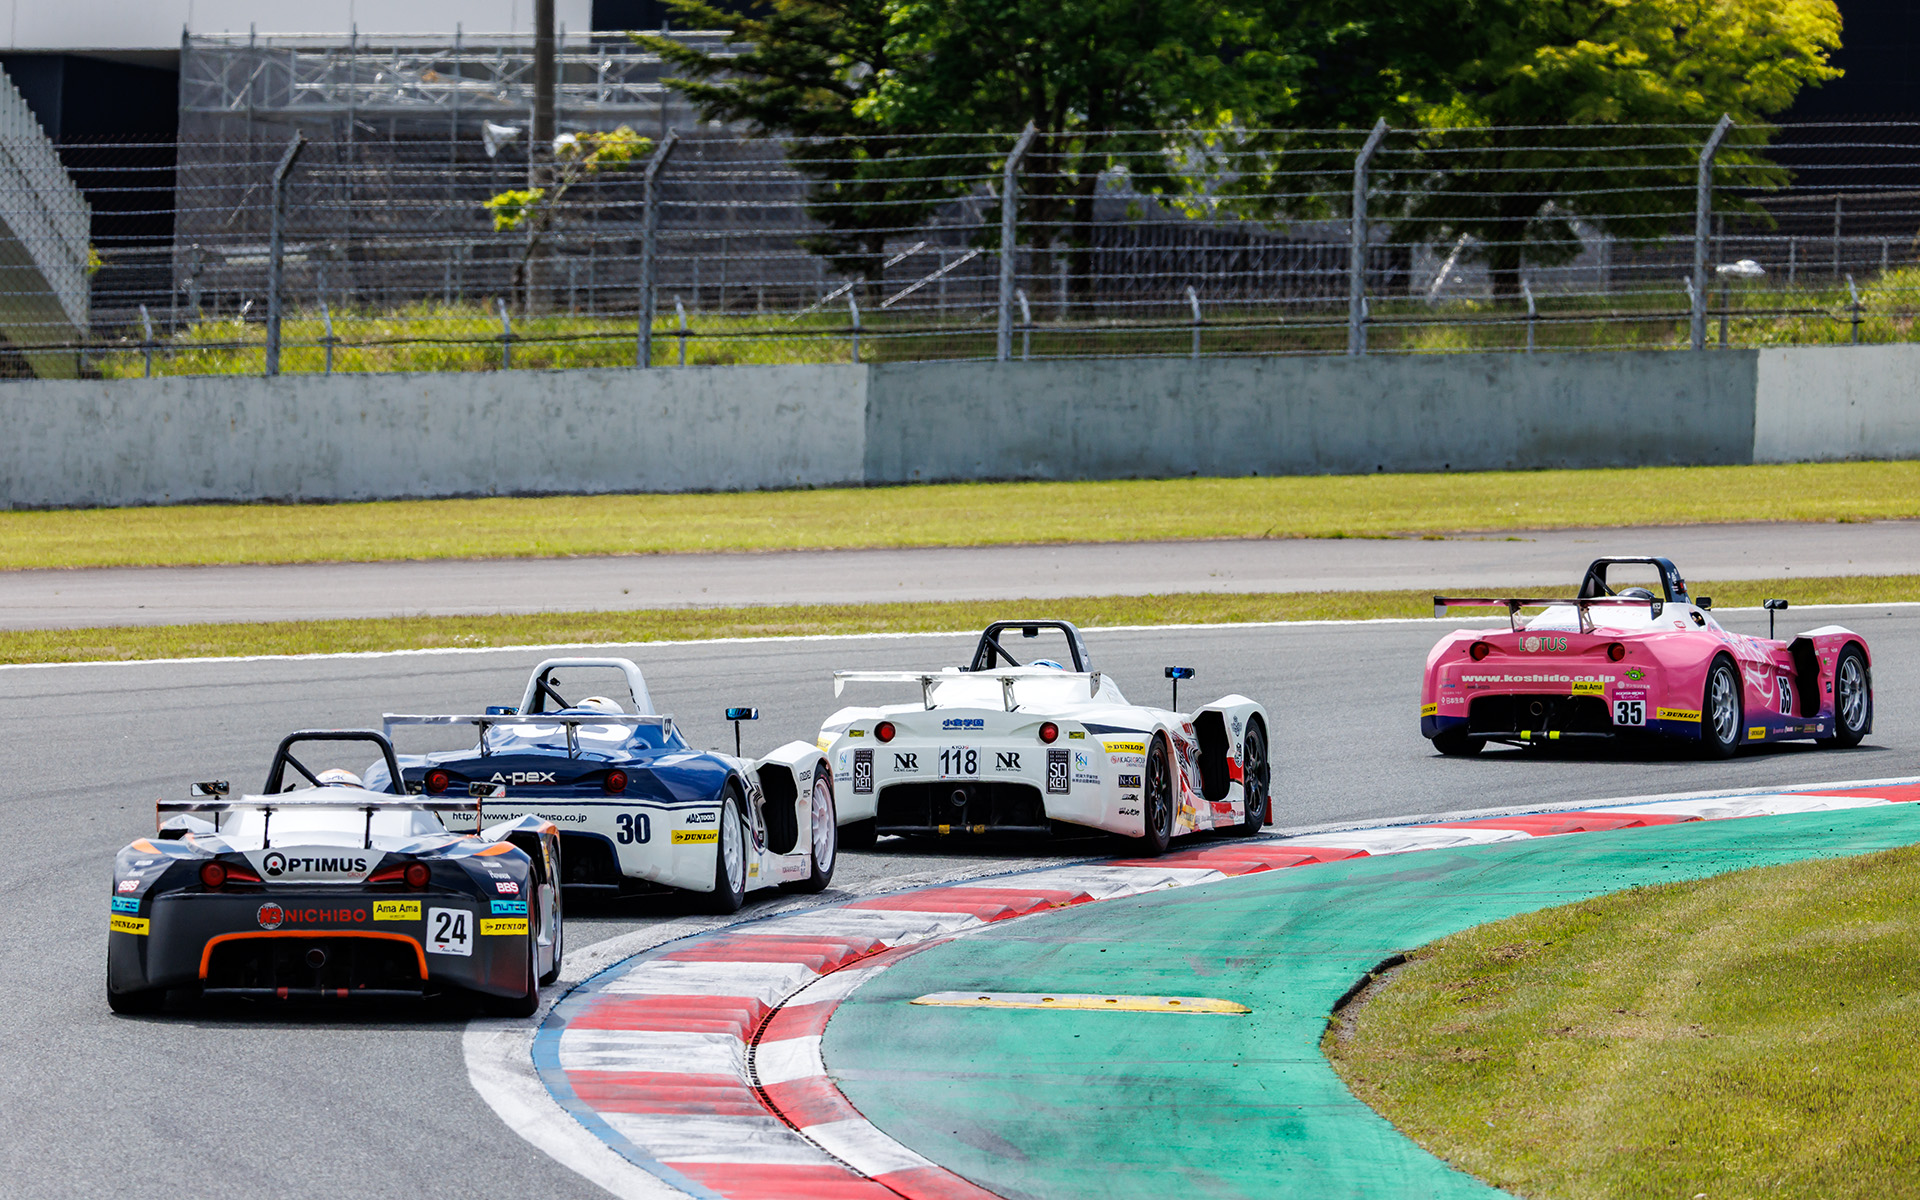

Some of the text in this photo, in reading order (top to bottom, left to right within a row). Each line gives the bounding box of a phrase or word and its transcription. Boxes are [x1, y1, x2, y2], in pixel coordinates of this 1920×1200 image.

[1461, 674, 1616, 683] www.koshido.co.jp
[1778, 677, 1791, 714] 35
[1617, 702, 1642, 725] 35
[1666, 711, 1699, 719] DUNLOP
[893, 753, 919, 769] NR
[940, 750, 977, 775] 118
[995, 752, 1021, 769] NR
[490, 771, 556, 786] A-pex
[616, 813, 651, 845] 30
[684, 833, 717, 841] DUNLOP
[118, 880, 139, 892] BBS
[495, 881, 519, 894] BBS
[285, 908, 367, 923] NICHIBO
[376, 903, 419, 913] Ama Ama
[434, 911, 467, 945] 24
[494, 923, 527, 931] DUNLOP
